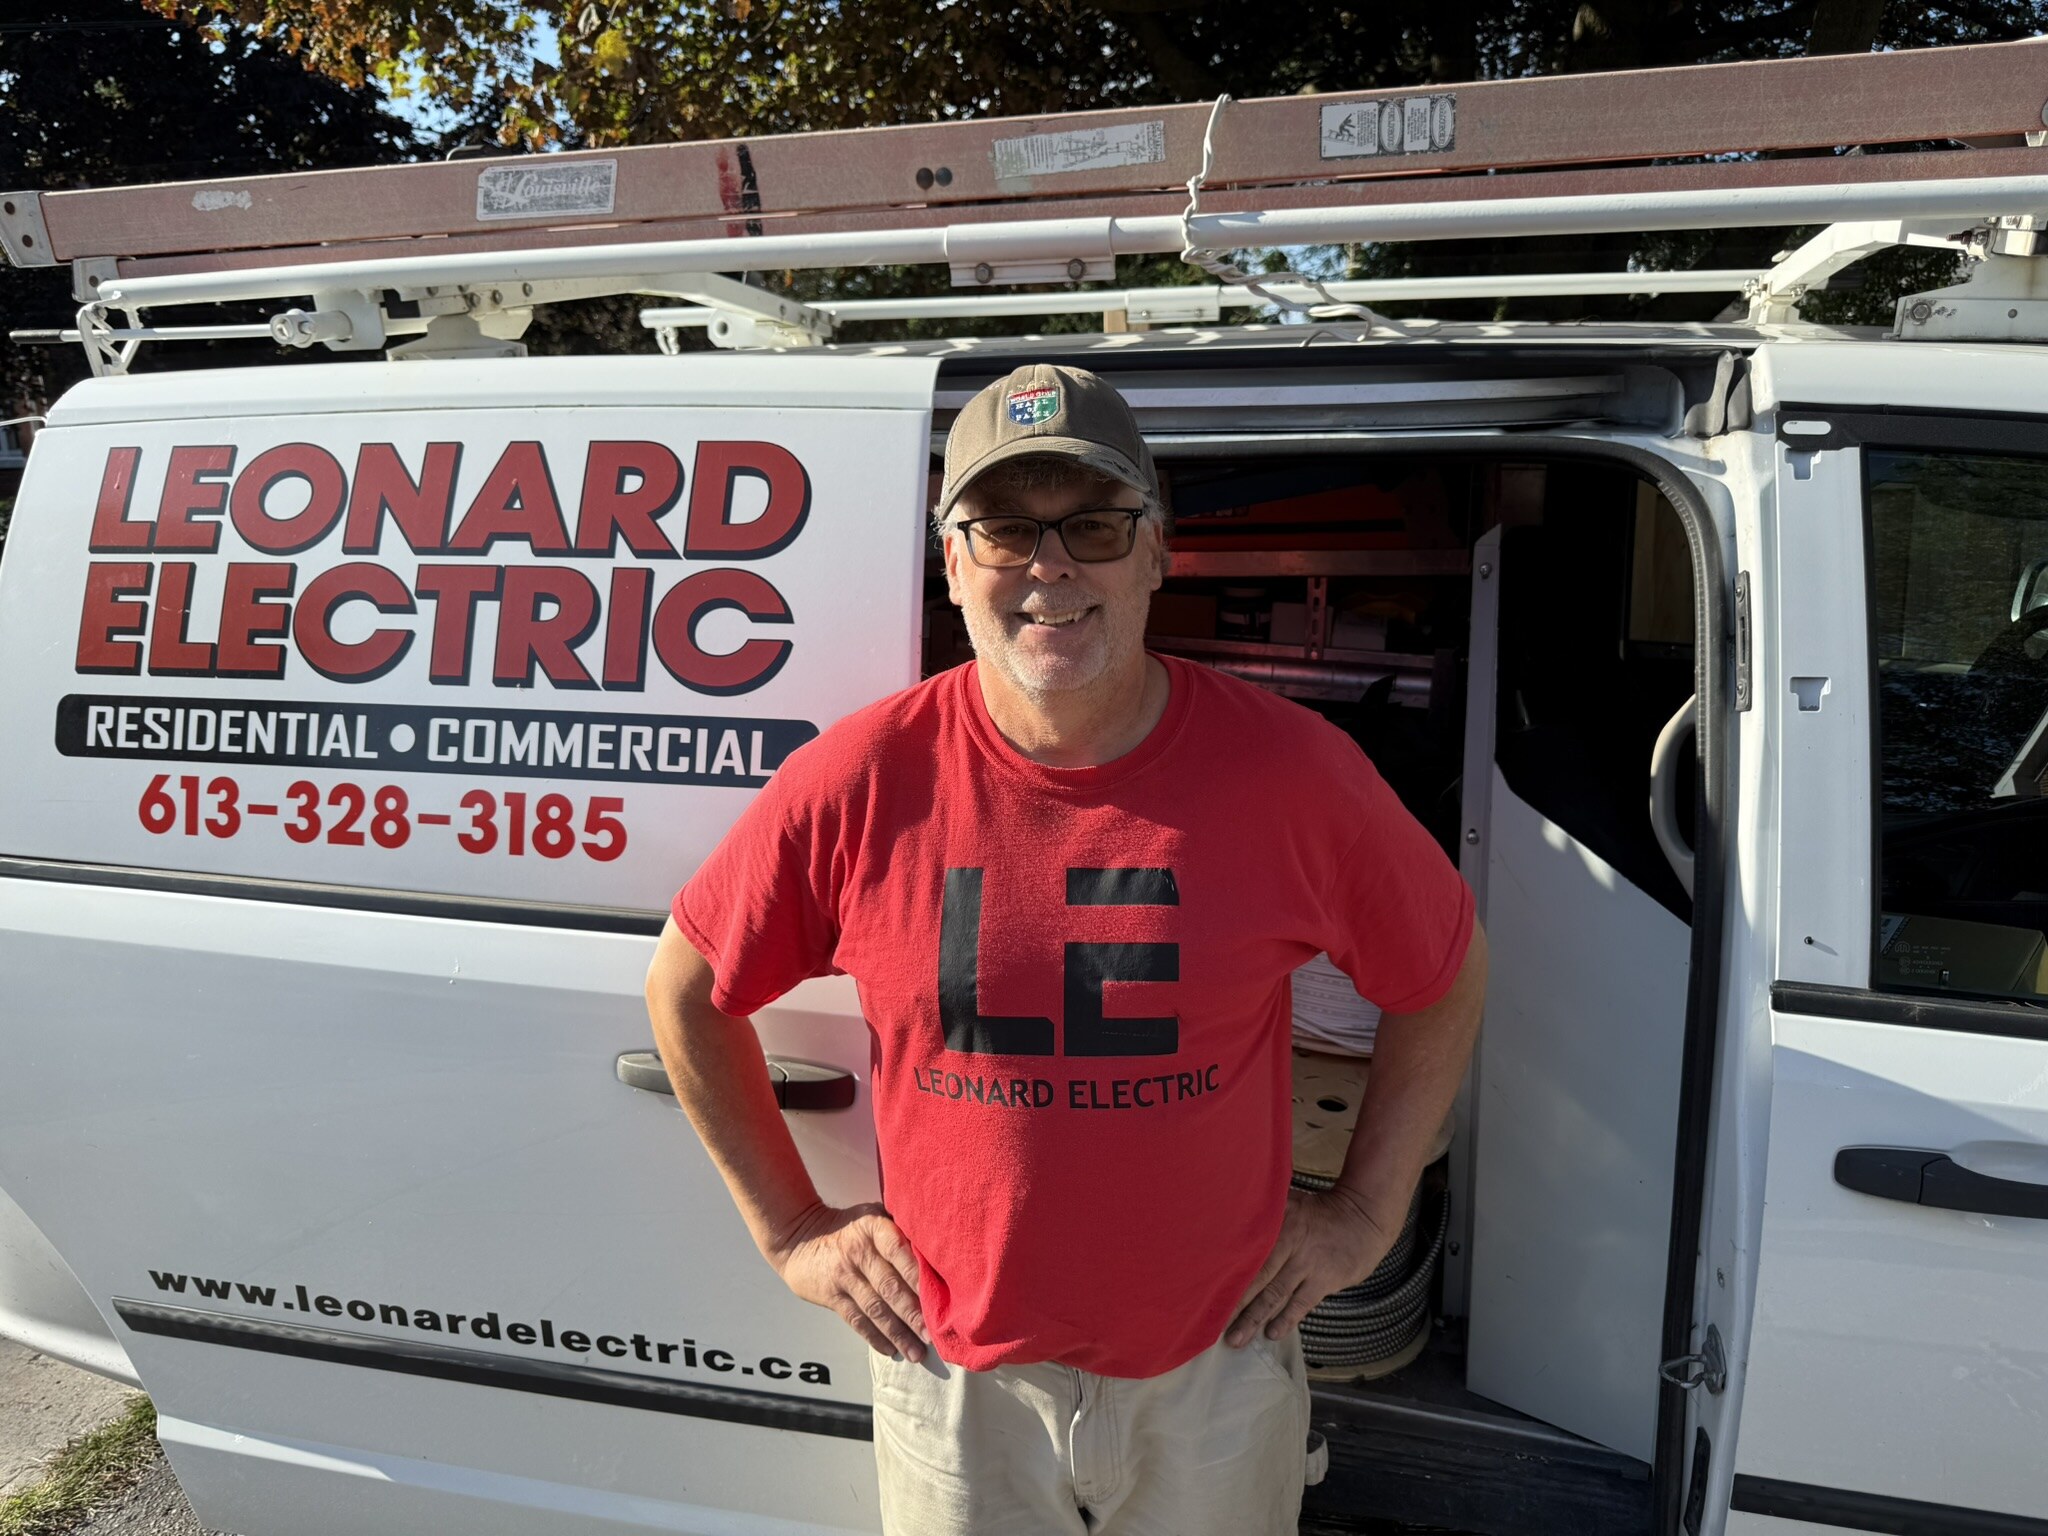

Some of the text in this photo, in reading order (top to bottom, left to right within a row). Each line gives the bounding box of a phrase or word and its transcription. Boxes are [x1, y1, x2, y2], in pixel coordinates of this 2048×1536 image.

[507, 172, 601, 206] Louisville
[1015, 398, 1049, 408] HALL
[1015, 410, 1050, 421] FAME
[88, 440, 812, 561] LEONARD
[75, 562, 795, 697] ELECTRIC
[86, 704, 777, 777] RESIDENTIAL COMMERCIAL
[138, 774, 628, 863] 613-328-3185
[938, 867, 1180, 1057] LE
[914, 1064, 1220, 1110] LEONARD ELECTRIC
[148, 1270, 832, 1386] www.leonardelectric.ca
